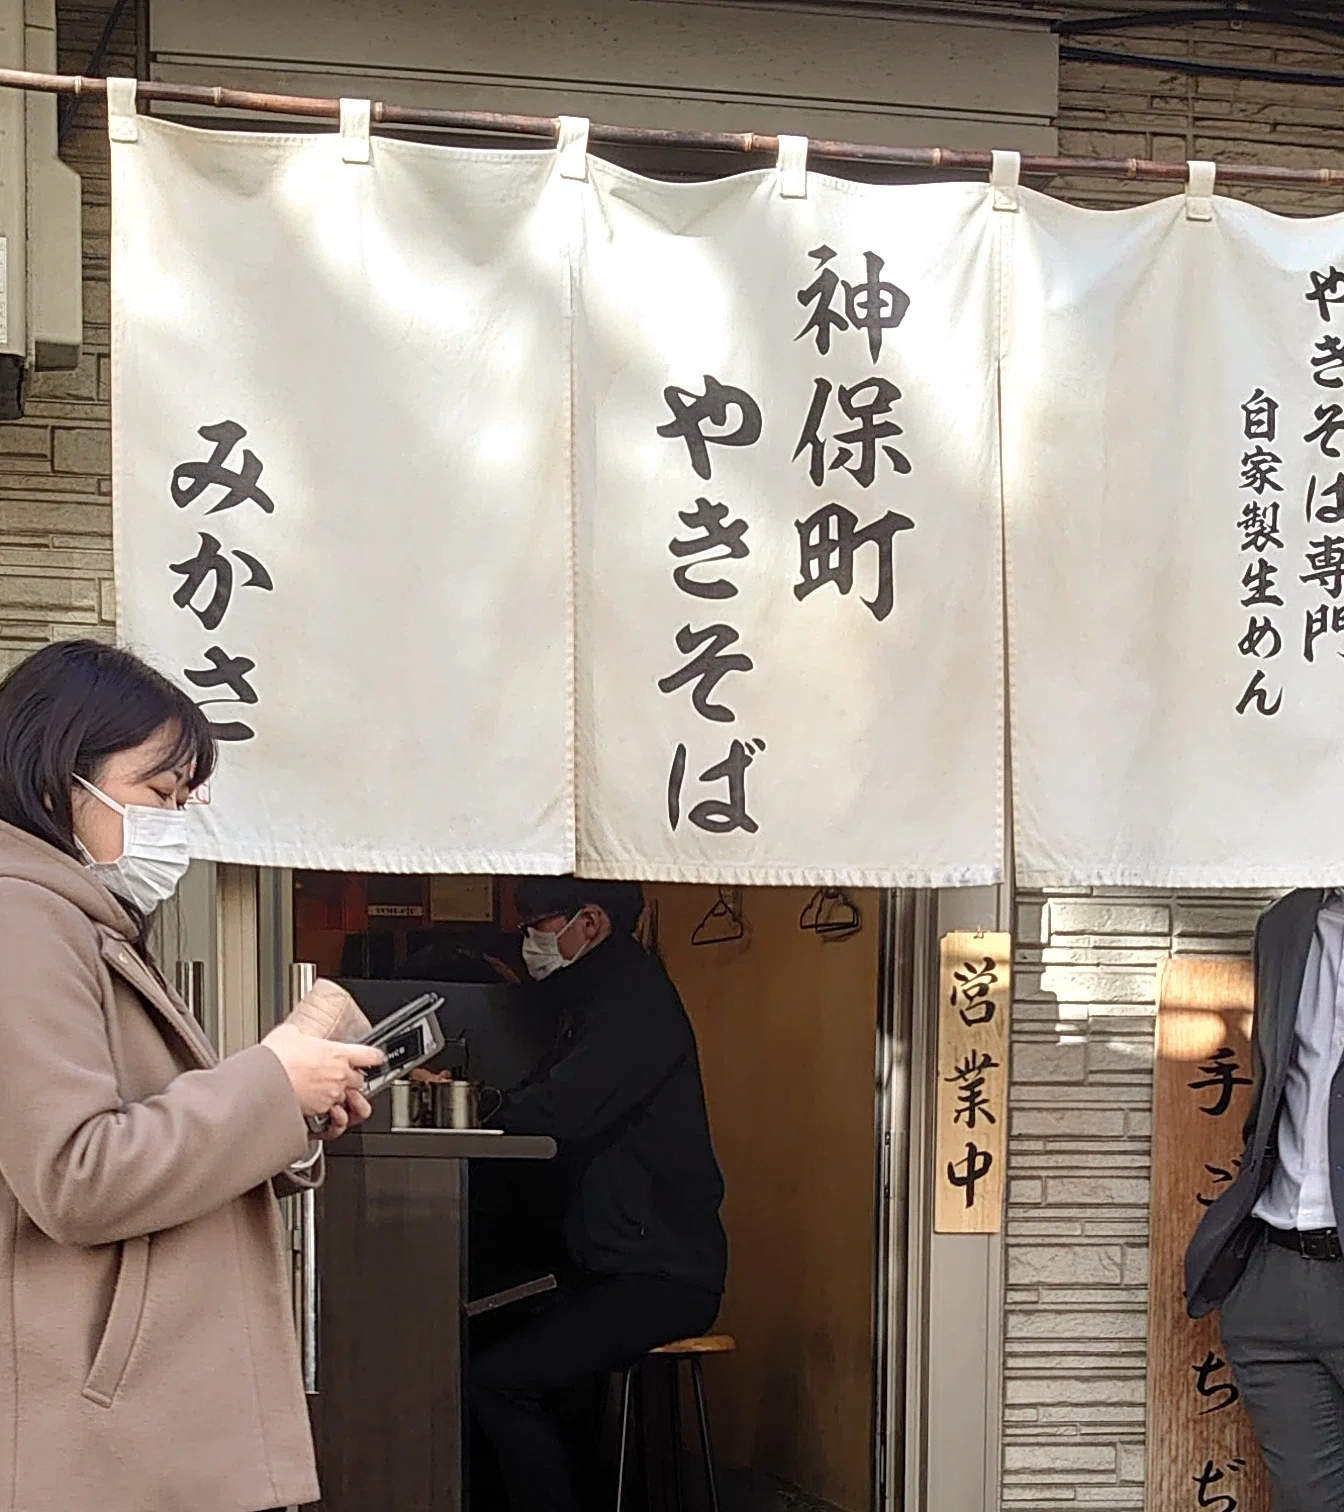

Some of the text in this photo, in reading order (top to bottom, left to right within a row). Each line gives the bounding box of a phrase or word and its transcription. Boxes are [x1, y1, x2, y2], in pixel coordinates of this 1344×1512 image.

[169, 419, 275, 742] みかさ
[791, 244, 915, 622] 神保町
[1235, 388, 1285, 716] 自家製生めん
[657, 374, 766, 835] やきそば
[944, 956, 1000, 1209] 営業中
